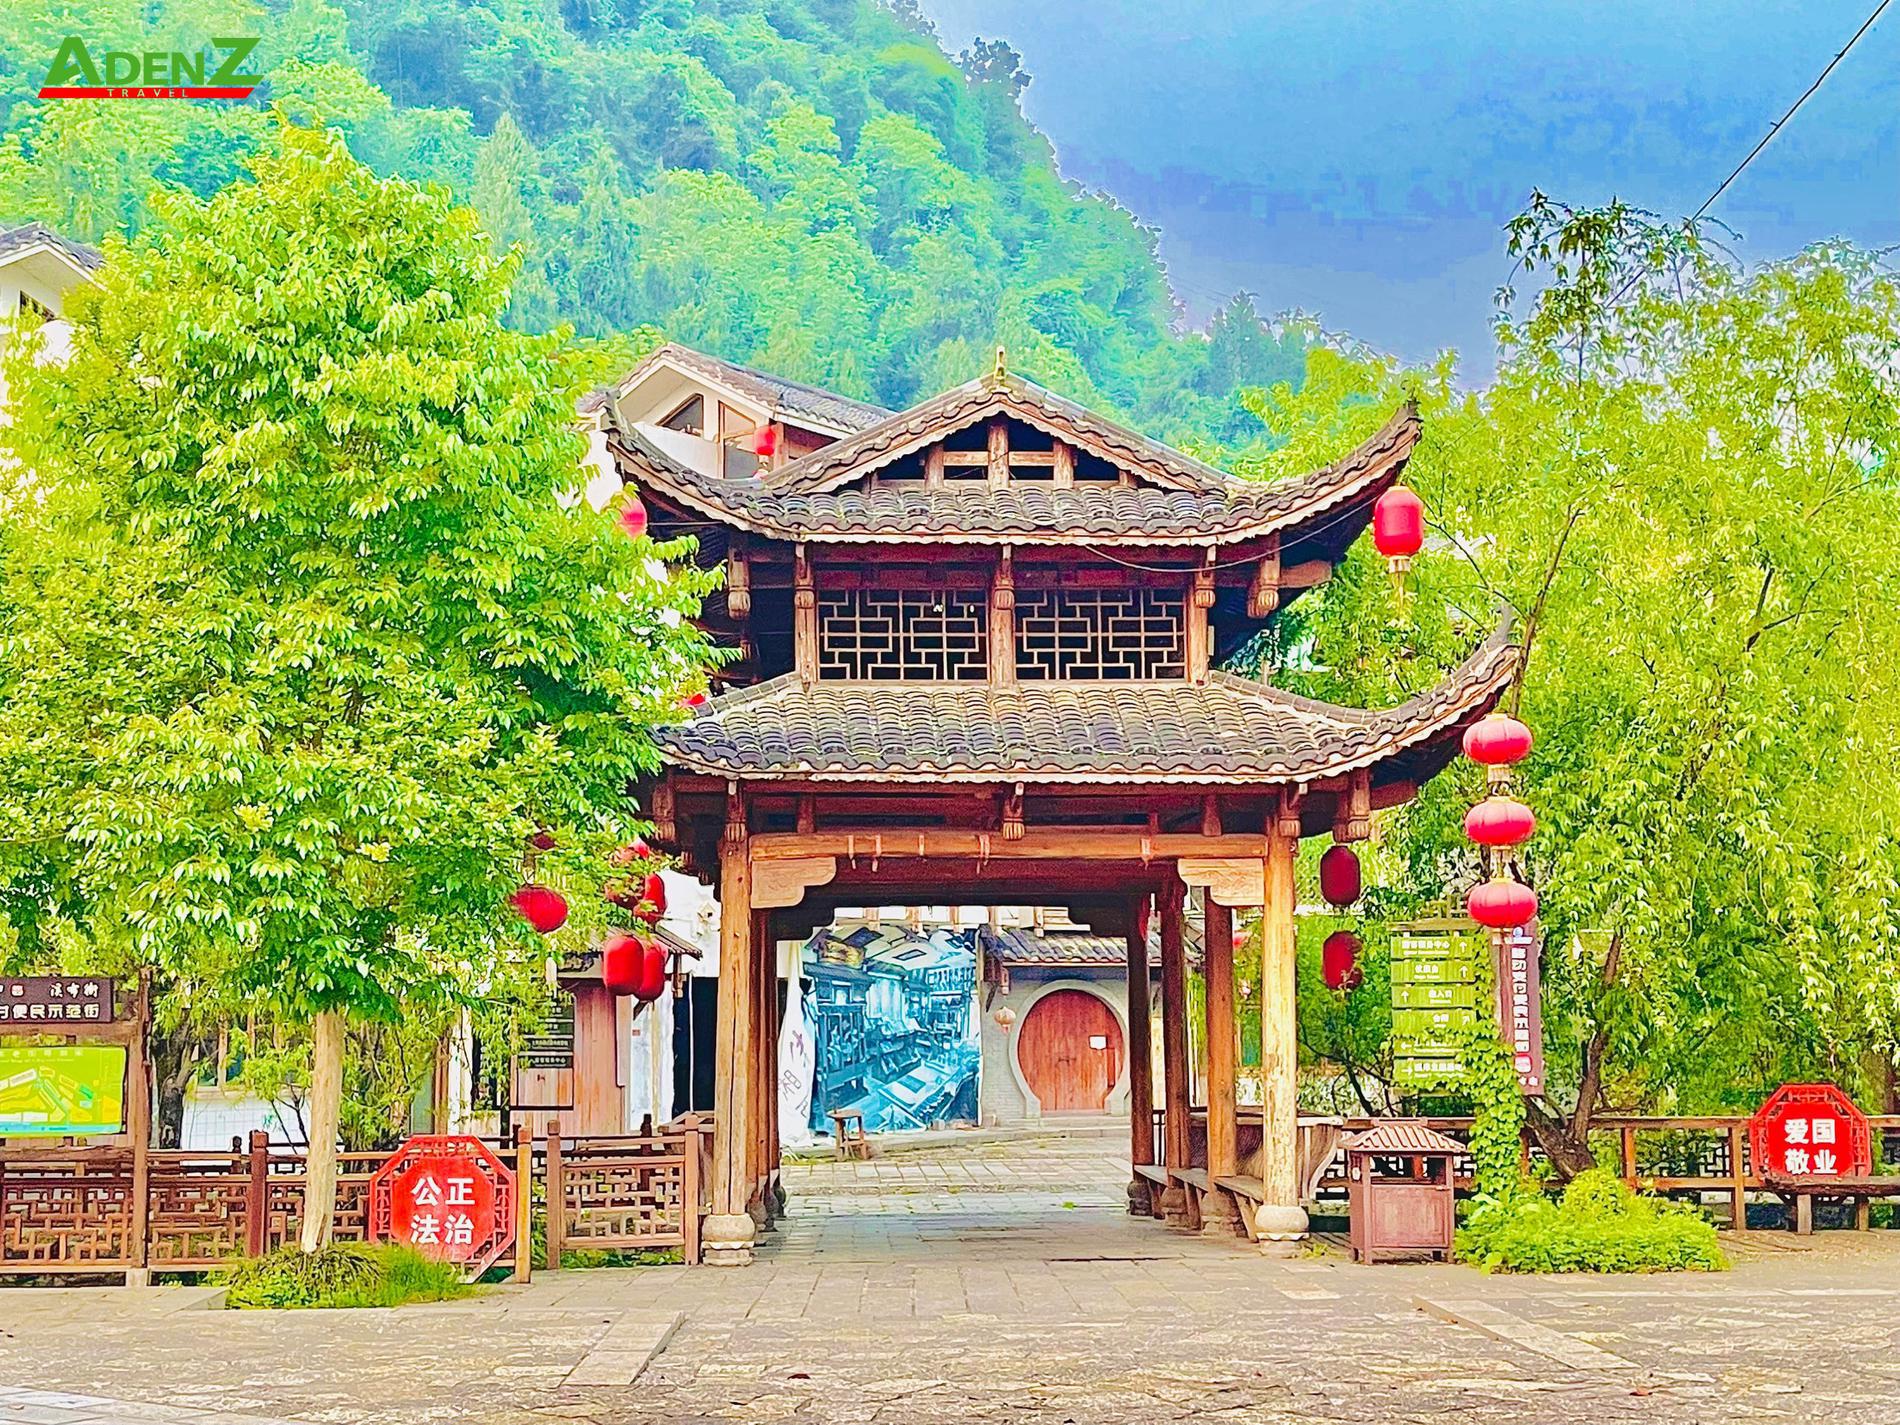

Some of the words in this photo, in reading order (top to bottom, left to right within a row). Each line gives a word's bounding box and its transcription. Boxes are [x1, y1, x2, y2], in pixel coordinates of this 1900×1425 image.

[1784, 1118, 1837, 1144] 爱国
[1784, 1148, 1838, 1175] 敬业
[410, 1176, 476, 1207] 公正
[410, 1213, 475, 1245] 法治
